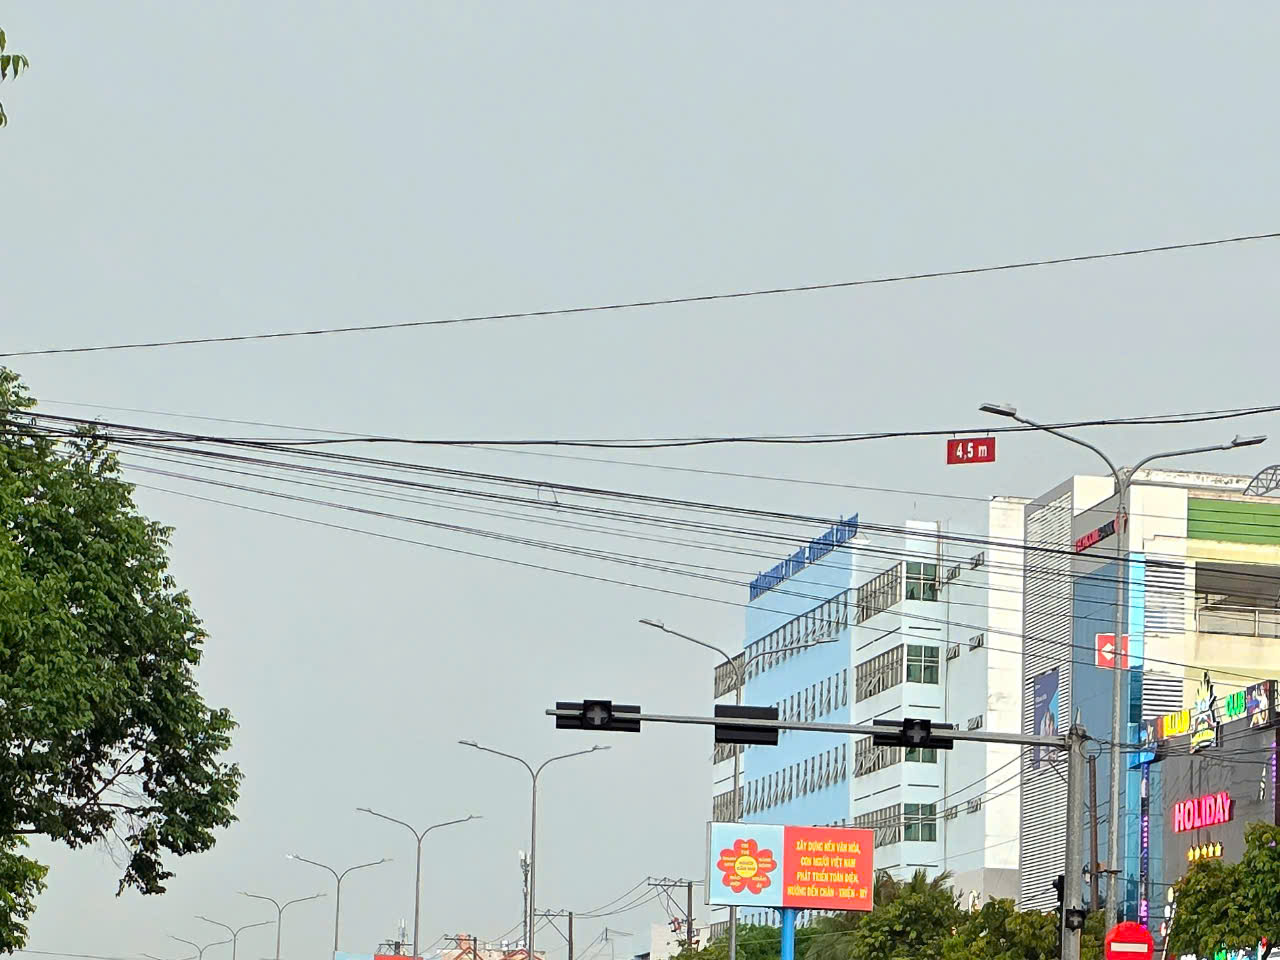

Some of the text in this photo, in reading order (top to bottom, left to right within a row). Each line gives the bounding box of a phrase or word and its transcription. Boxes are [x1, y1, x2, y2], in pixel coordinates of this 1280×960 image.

[956, 442, 988, 461] 4,5 m
[1174, 792, 1232, 833] HOLIDAY
